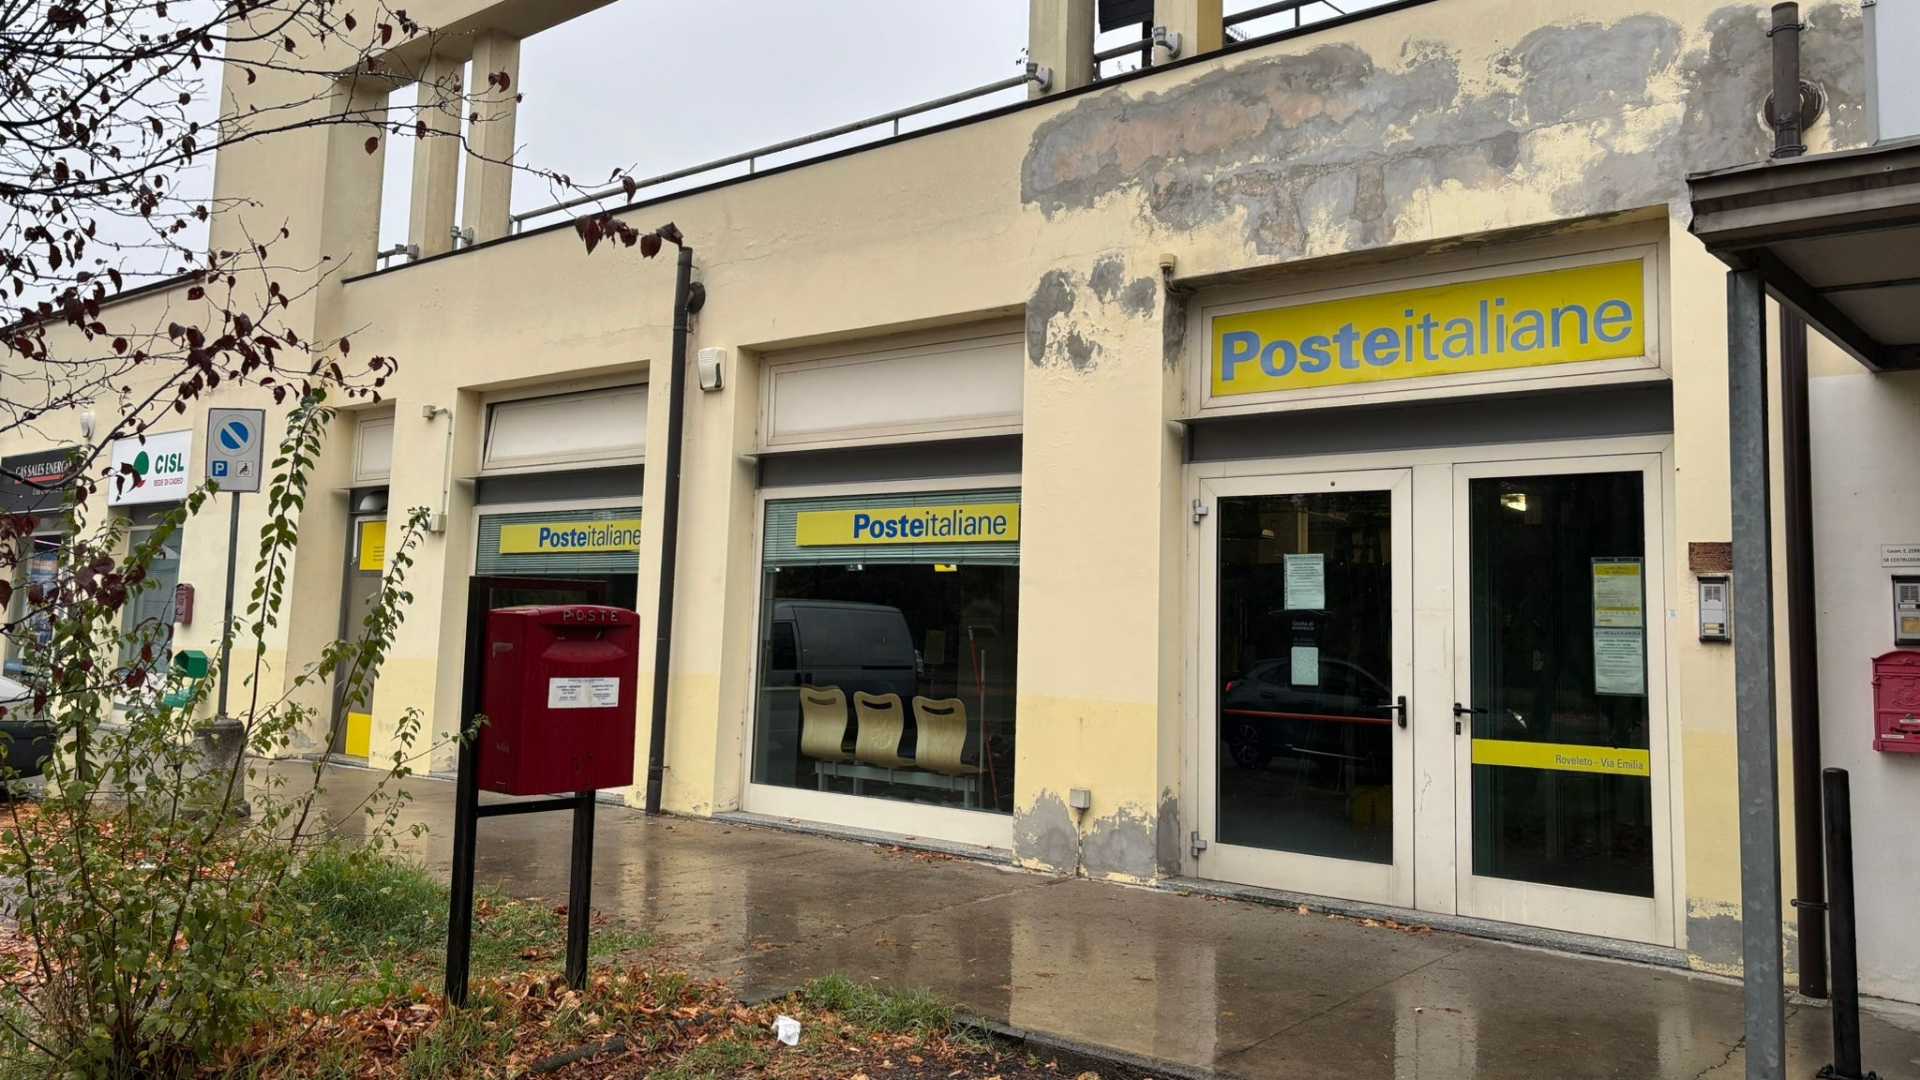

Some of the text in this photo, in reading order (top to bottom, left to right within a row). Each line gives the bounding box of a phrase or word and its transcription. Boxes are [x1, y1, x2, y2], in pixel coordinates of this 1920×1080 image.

[1221, 298, 1633, 382] Posteitaliane
[27, 463, 45, 476] SALES
[45, 460, 72, 475] ENERG
[155, 452, 184, 474] CISL
[215, 462, 225, 475] P
[853, 509, 1007, 539] Posteitaliane
[538, 524, 641, 548] Posteitaliane
[563, 608, 618, 622] POSTE
[1555, 754, 1593, 767] Roveleto
[1601, 757, 1615, 768] Via
[1617, 758, 1644, 770] Emilia
